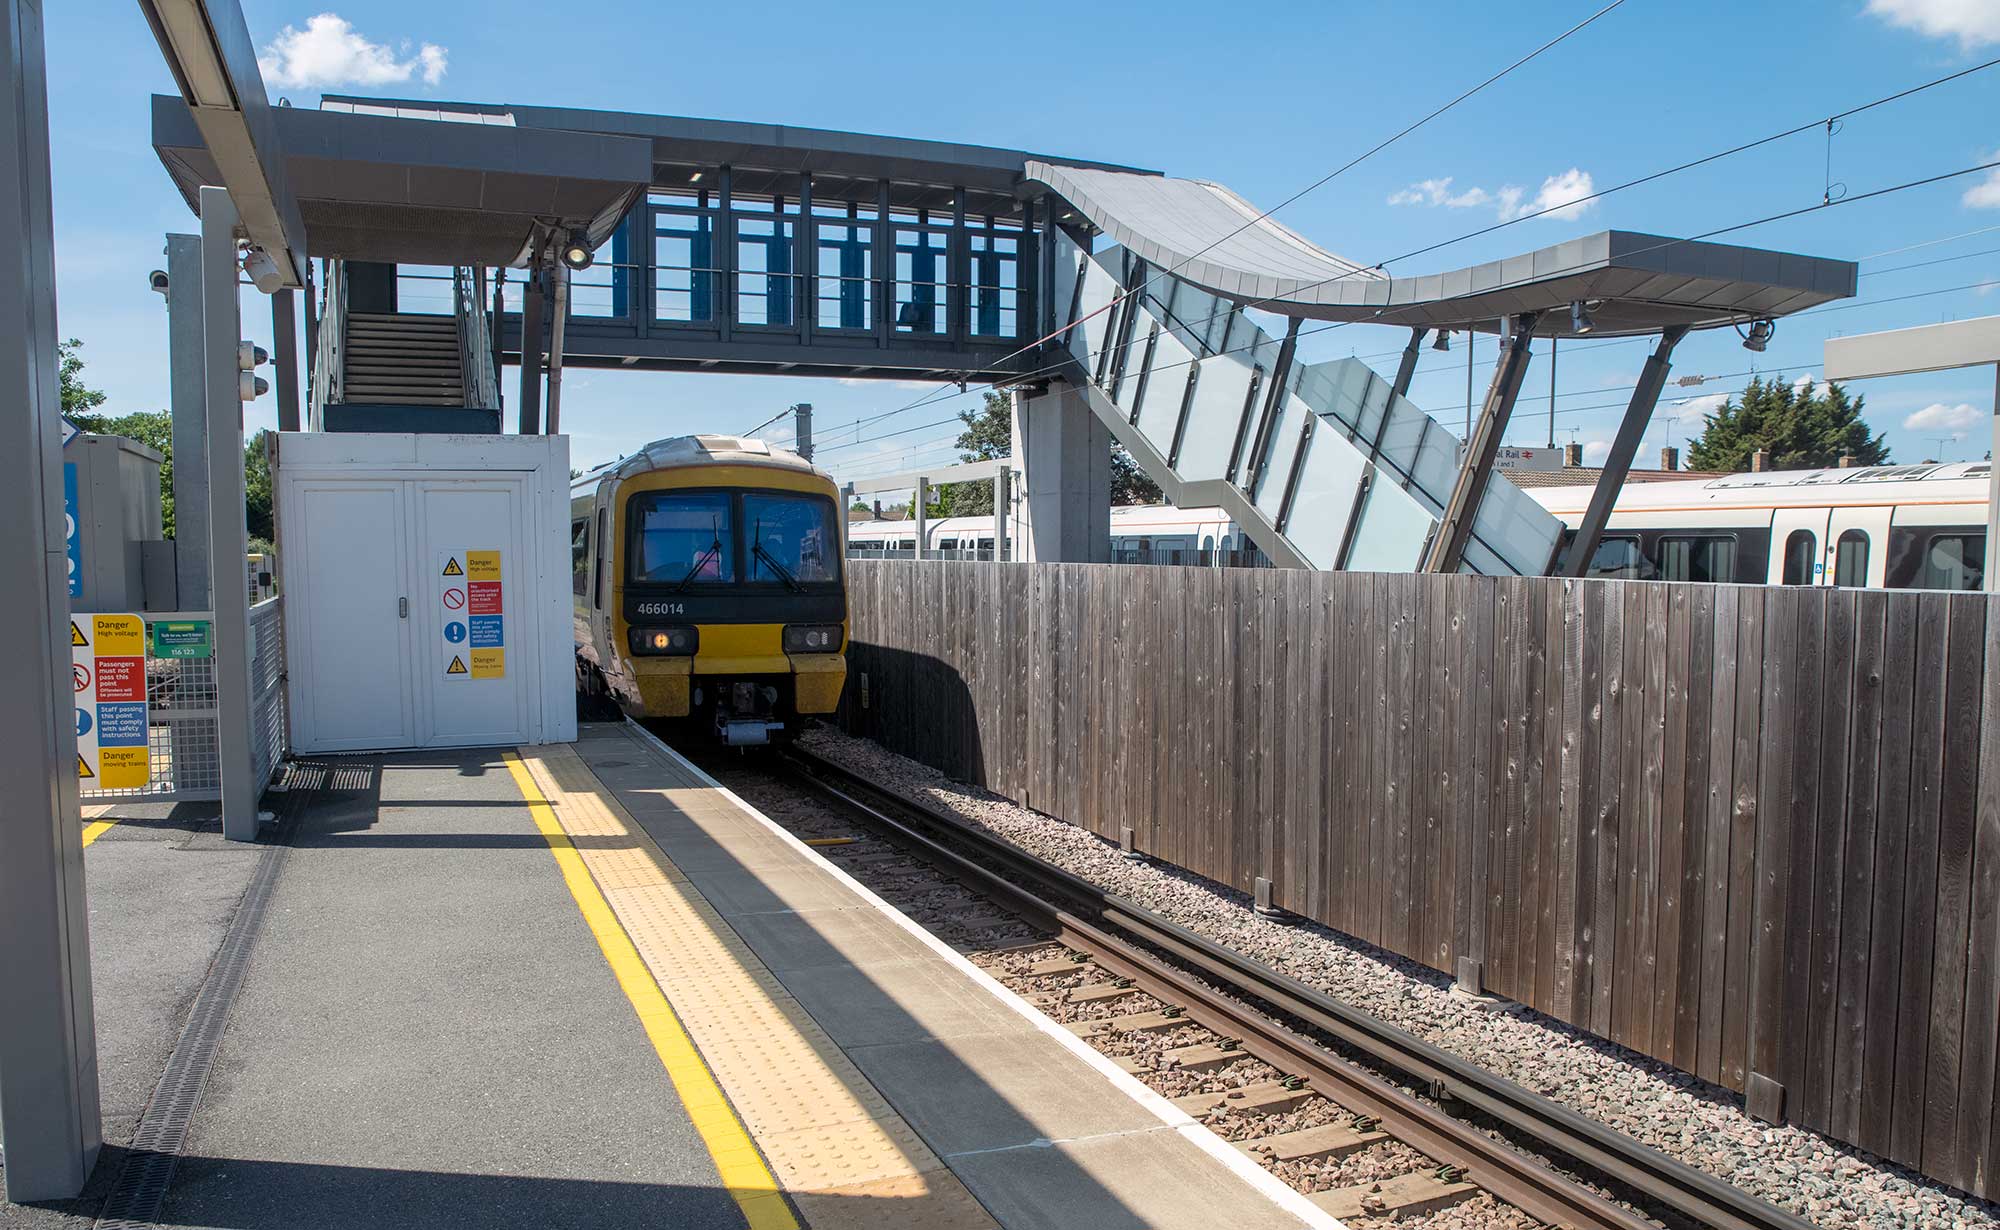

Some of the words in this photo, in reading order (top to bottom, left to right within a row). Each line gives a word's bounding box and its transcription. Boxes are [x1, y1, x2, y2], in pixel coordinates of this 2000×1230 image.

[1505, 450, 1520, 458] Rail
[638, 603, 684, 614] 466014
[97, 621, 129, 630] Danger
[103, 752, 134, 760] Danger
